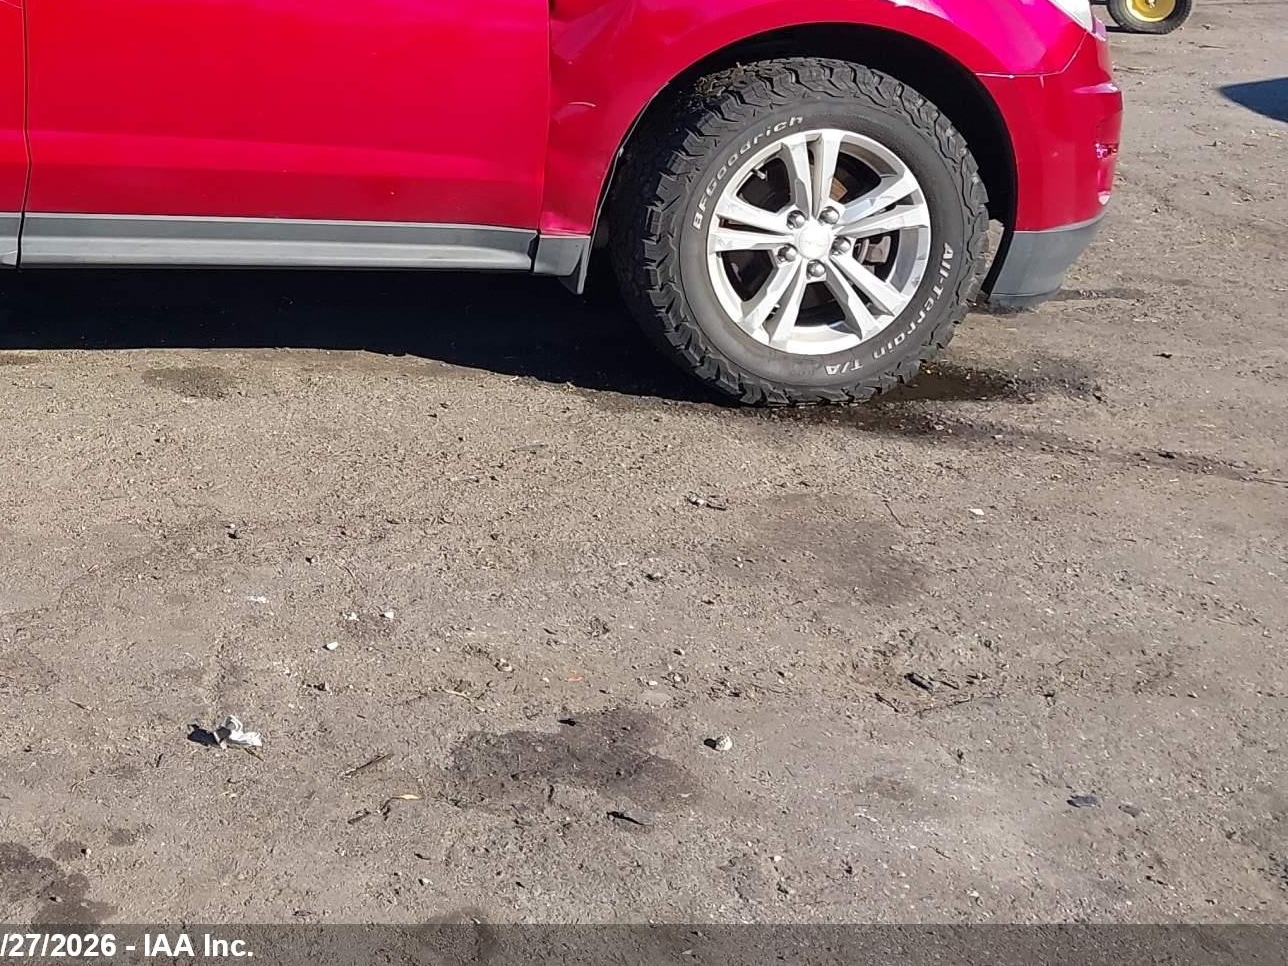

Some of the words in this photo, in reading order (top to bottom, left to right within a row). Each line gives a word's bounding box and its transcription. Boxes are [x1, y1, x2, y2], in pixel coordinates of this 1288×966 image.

[692, 115, 804, 230] BFGoodrich
[873, 242, 954, 359] All-Terrain
[824, 361, 864, 377] T/A
